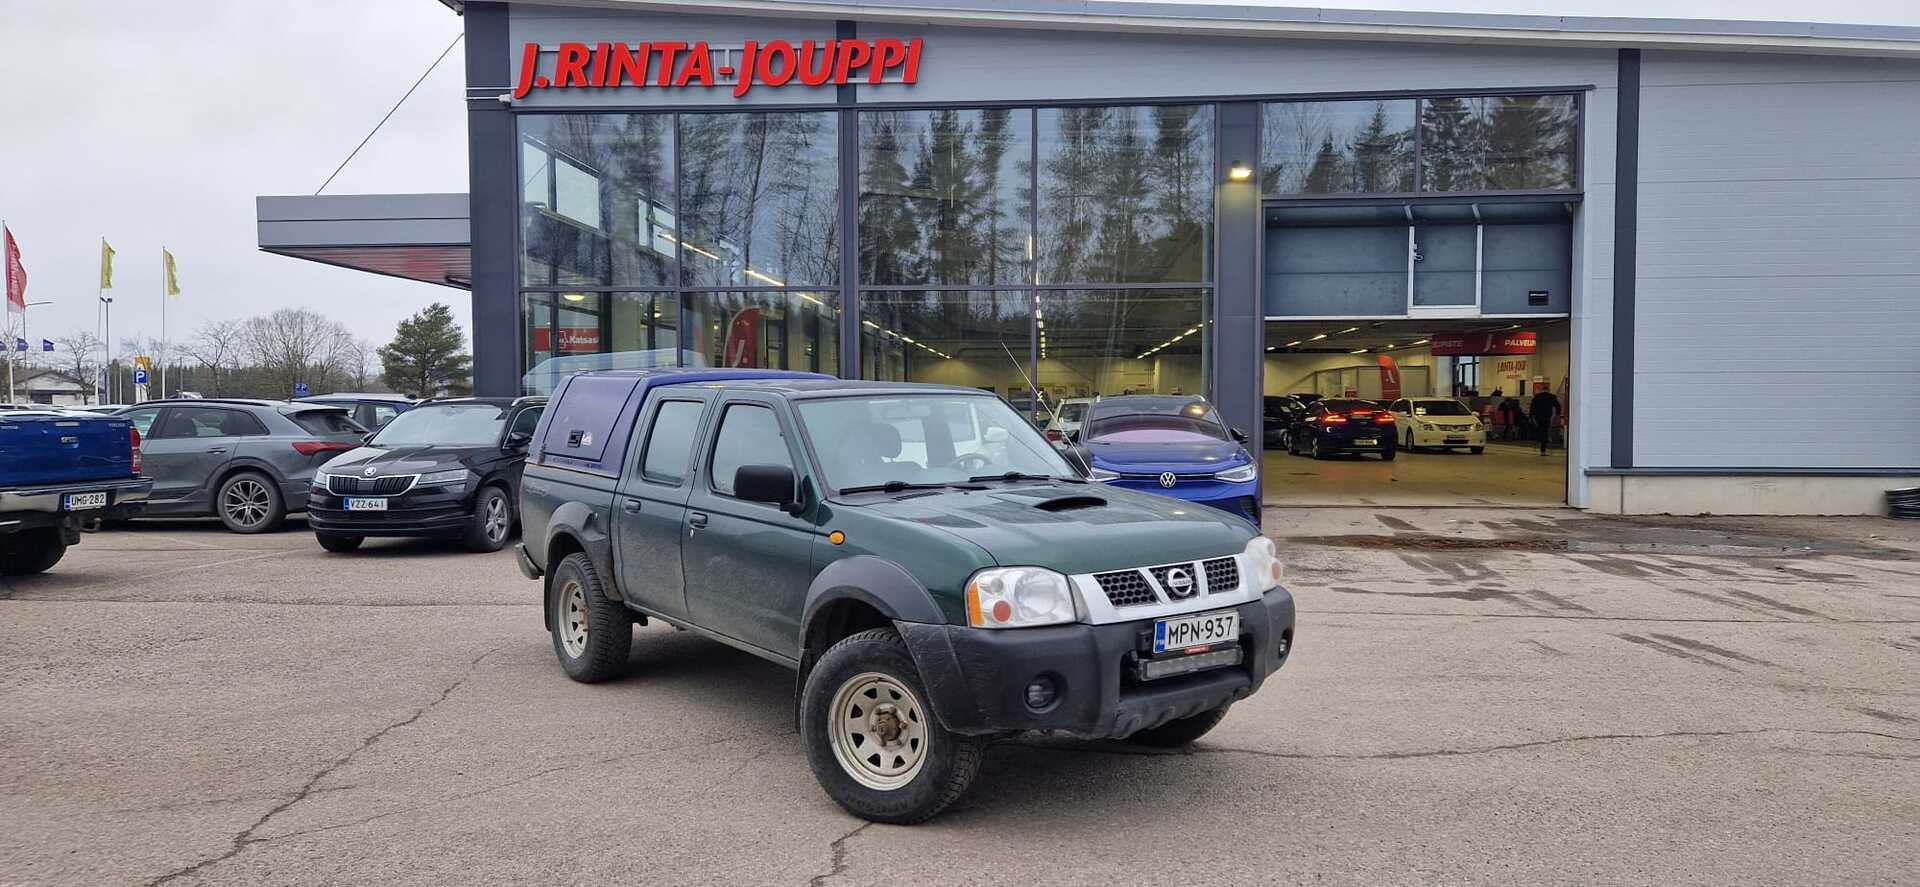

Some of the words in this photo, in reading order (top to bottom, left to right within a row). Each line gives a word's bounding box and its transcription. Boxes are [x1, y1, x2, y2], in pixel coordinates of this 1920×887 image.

[514, 38, 923, 99] J.RINTA-JOUPPI
[136, 371, 146, 383] P
[1168, 615, 1234, 646] MPN-937
